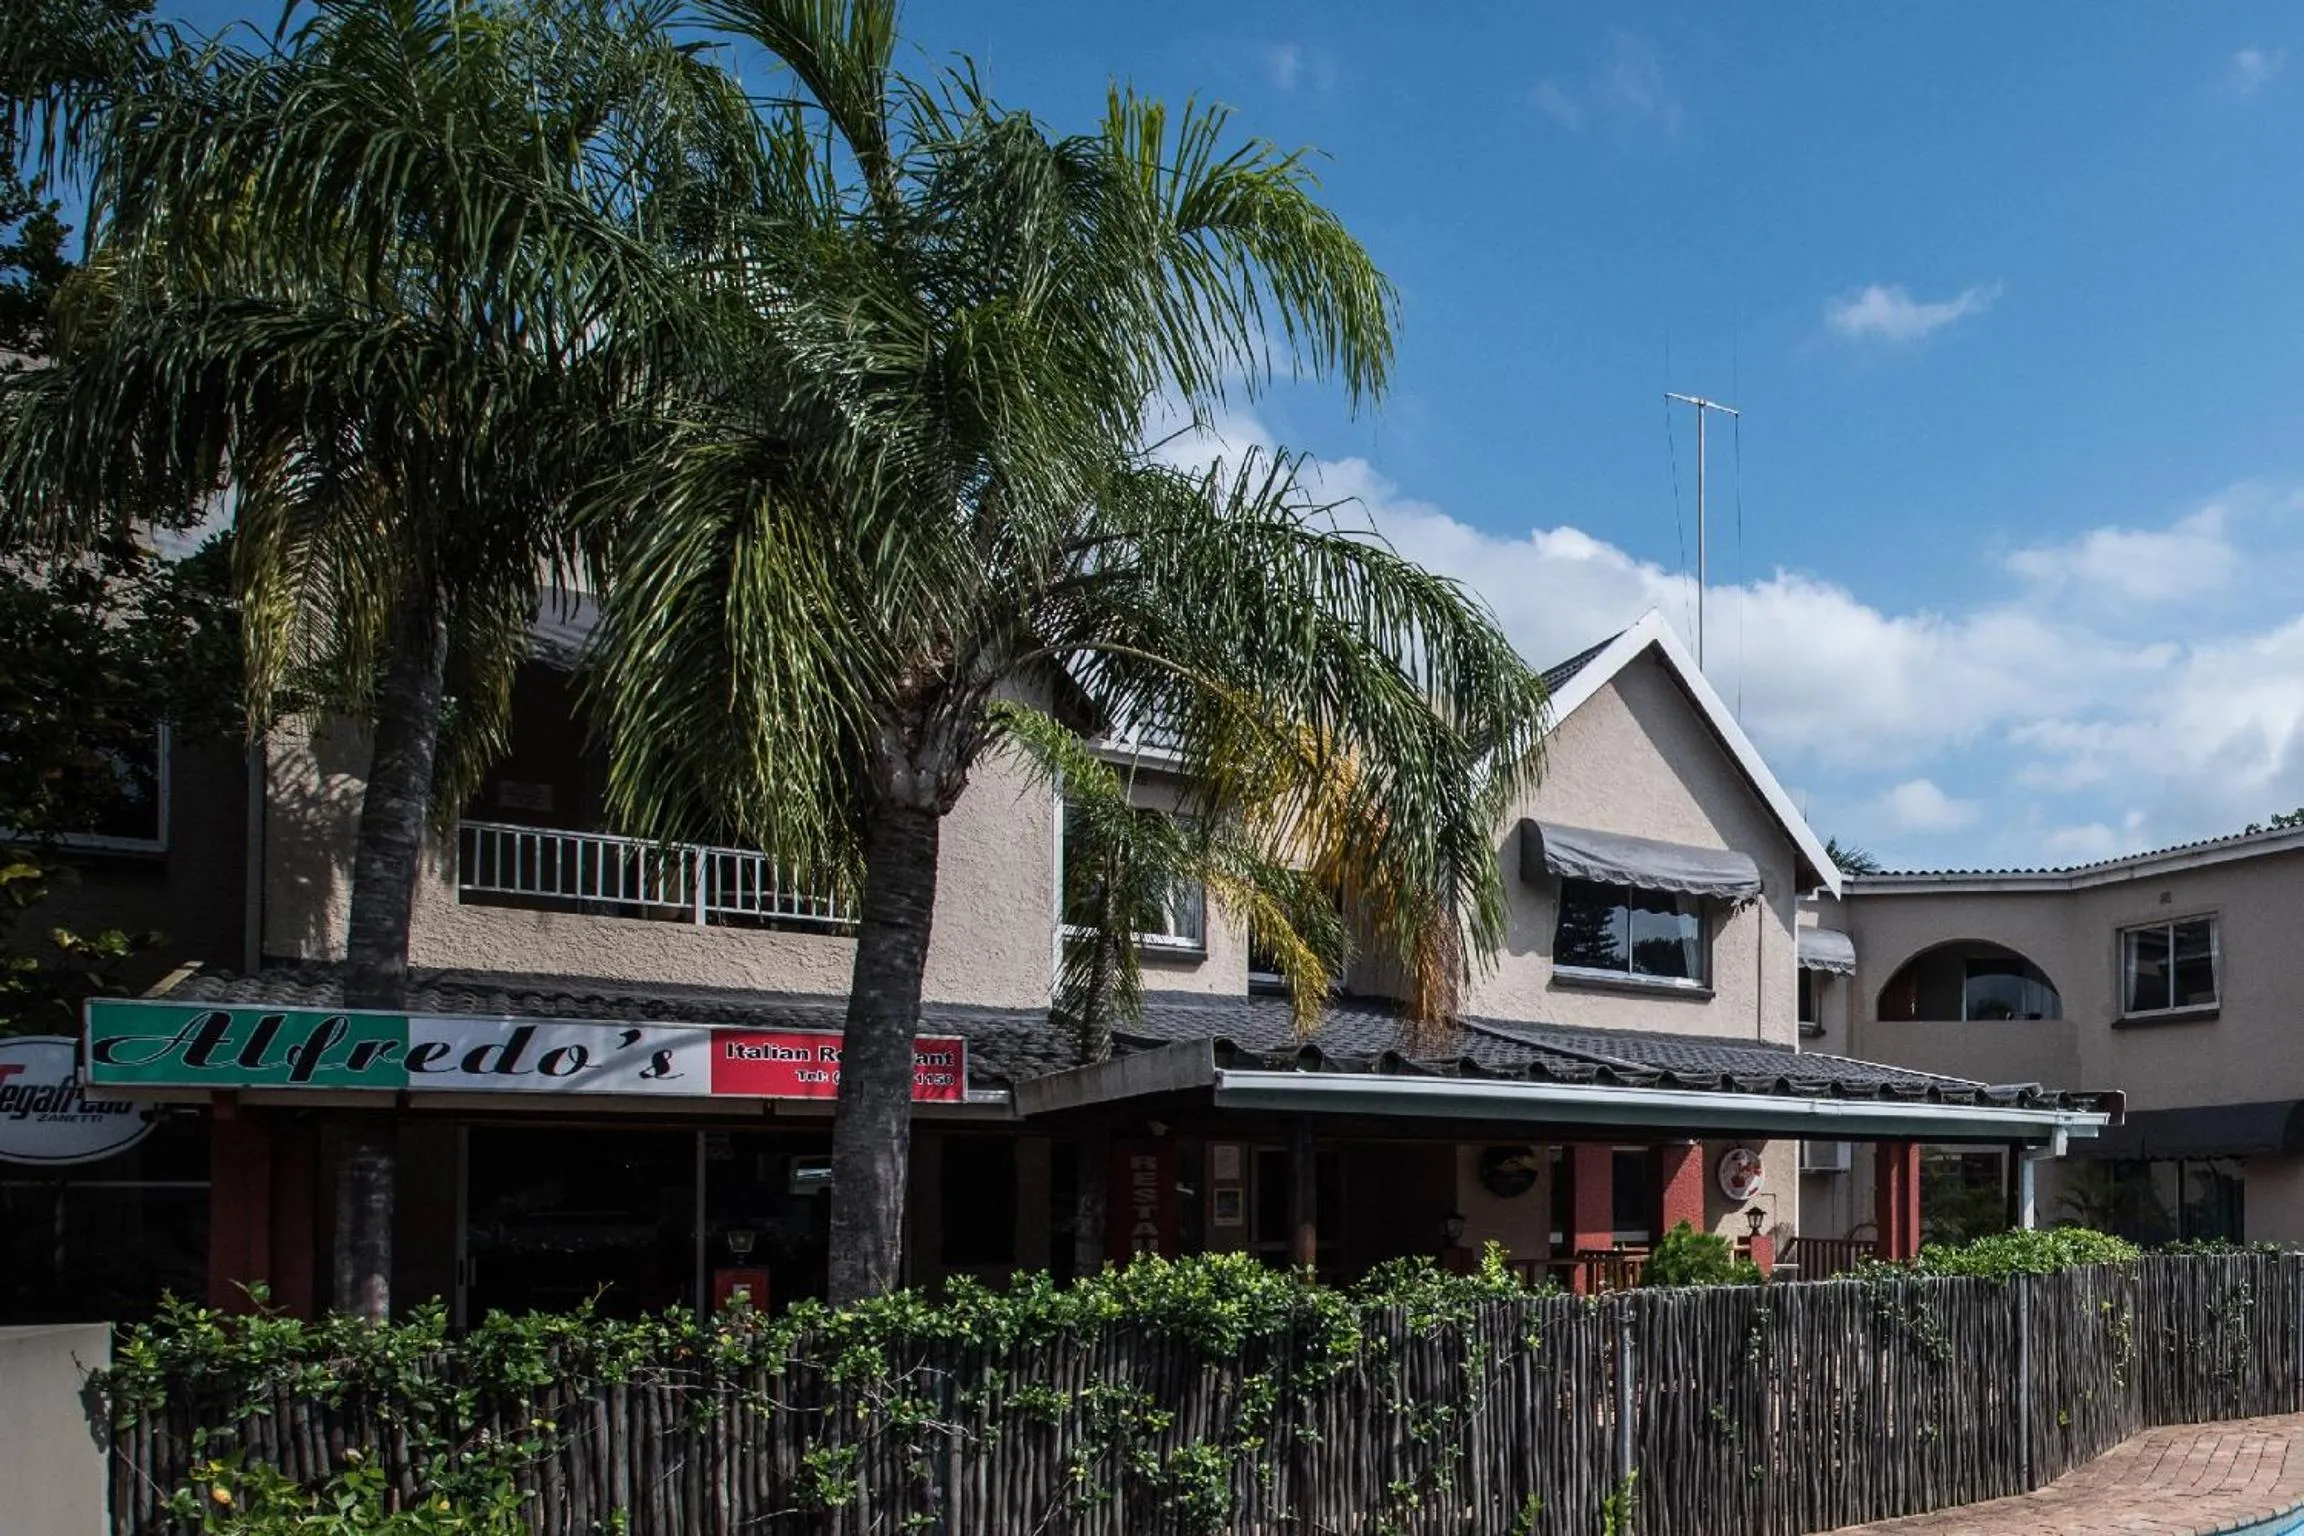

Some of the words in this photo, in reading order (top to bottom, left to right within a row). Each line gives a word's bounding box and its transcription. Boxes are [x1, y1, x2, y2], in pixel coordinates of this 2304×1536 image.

[92, 1011, 685, 1083] Alfredo's
[726, 1041, 810, 1062] Italian
[795, 1069, 829, 1082] Tel:
[36, 1113, 104, 1123] ZANETTI
